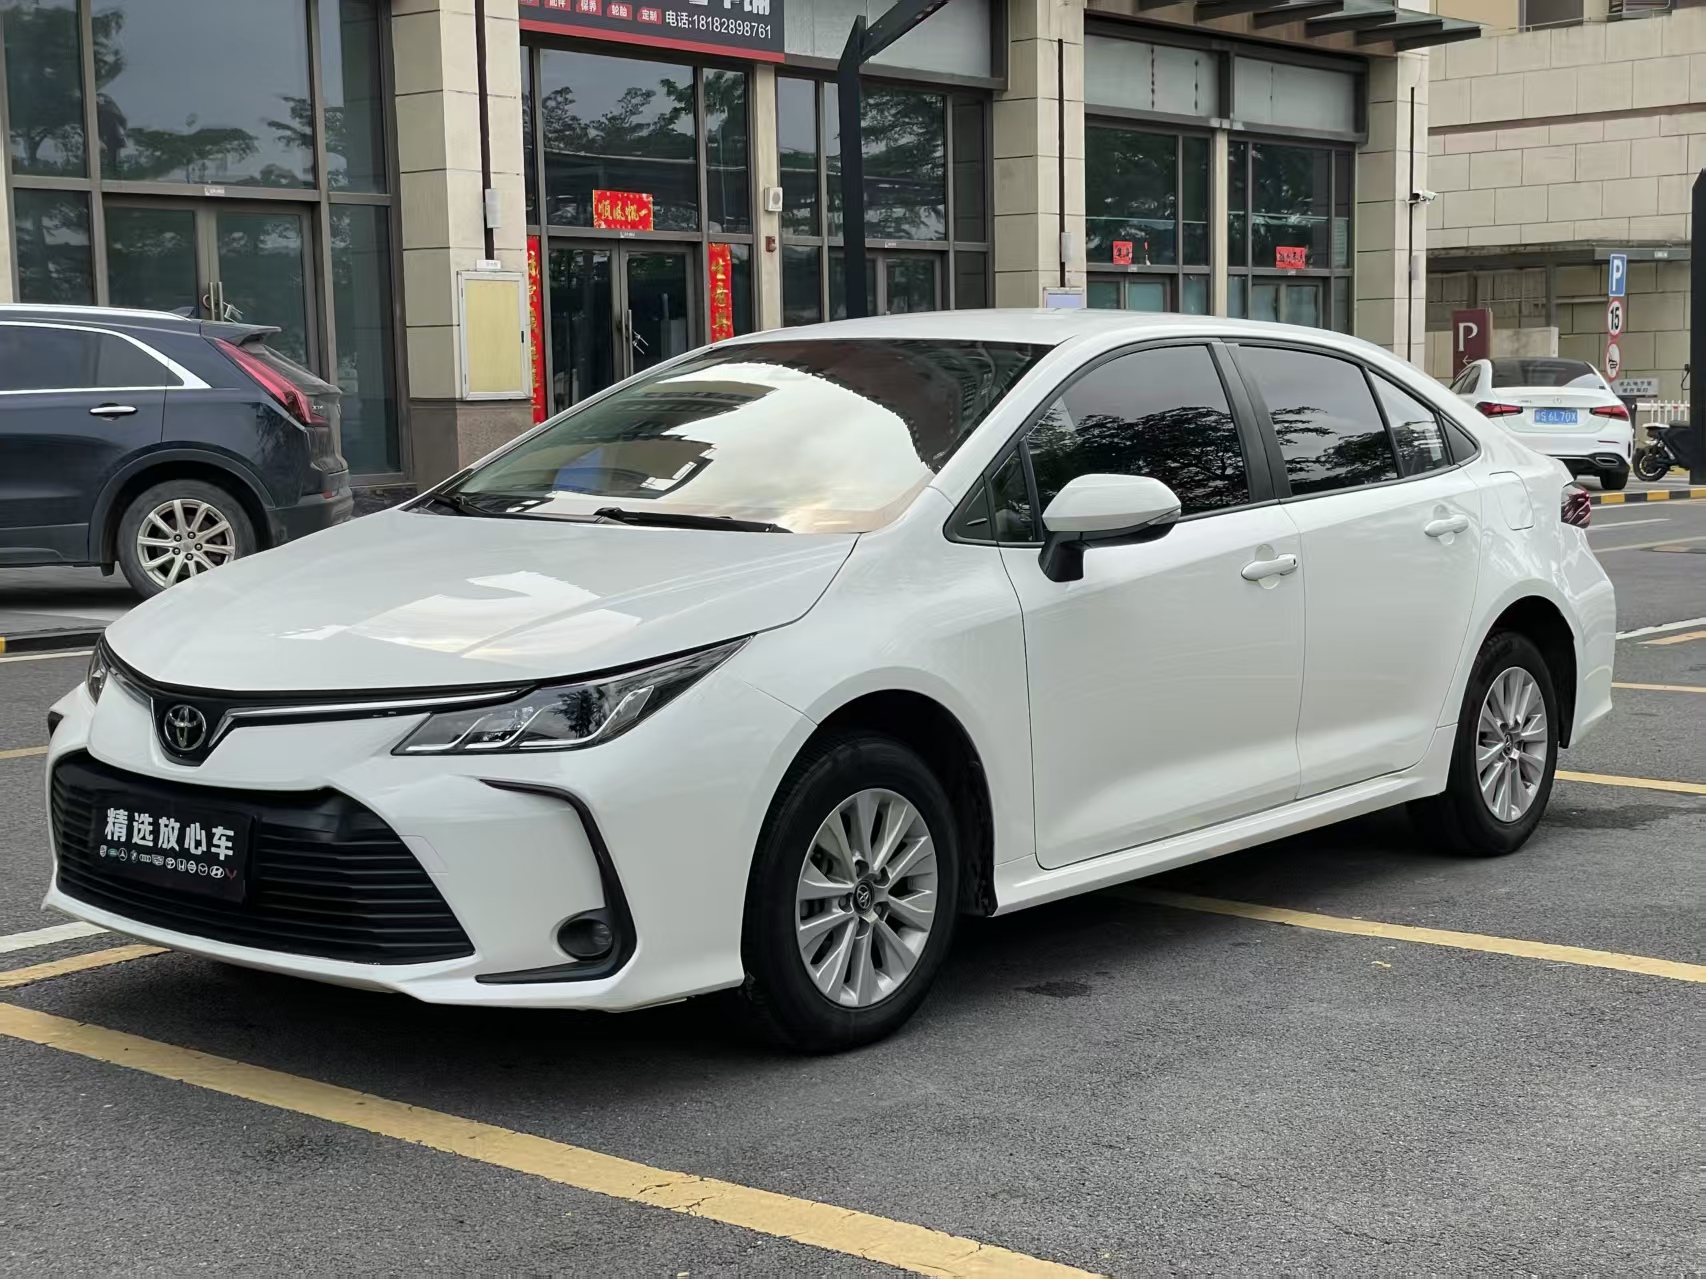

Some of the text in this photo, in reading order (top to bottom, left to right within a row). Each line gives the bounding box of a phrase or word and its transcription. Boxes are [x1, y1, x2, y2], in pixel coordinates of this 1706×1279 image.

[611, 5, 628, 17] 轮胎
[642, 9, 658, 21] 定制
[665, 10, 771, 39] 电话:18182898761
[1612, 259, 1623, 291] P
[1610, 306, 1620, 330] 15
[1458, 322, 1478, 352] P
[104, 807, 235, 861] 精选放心车
